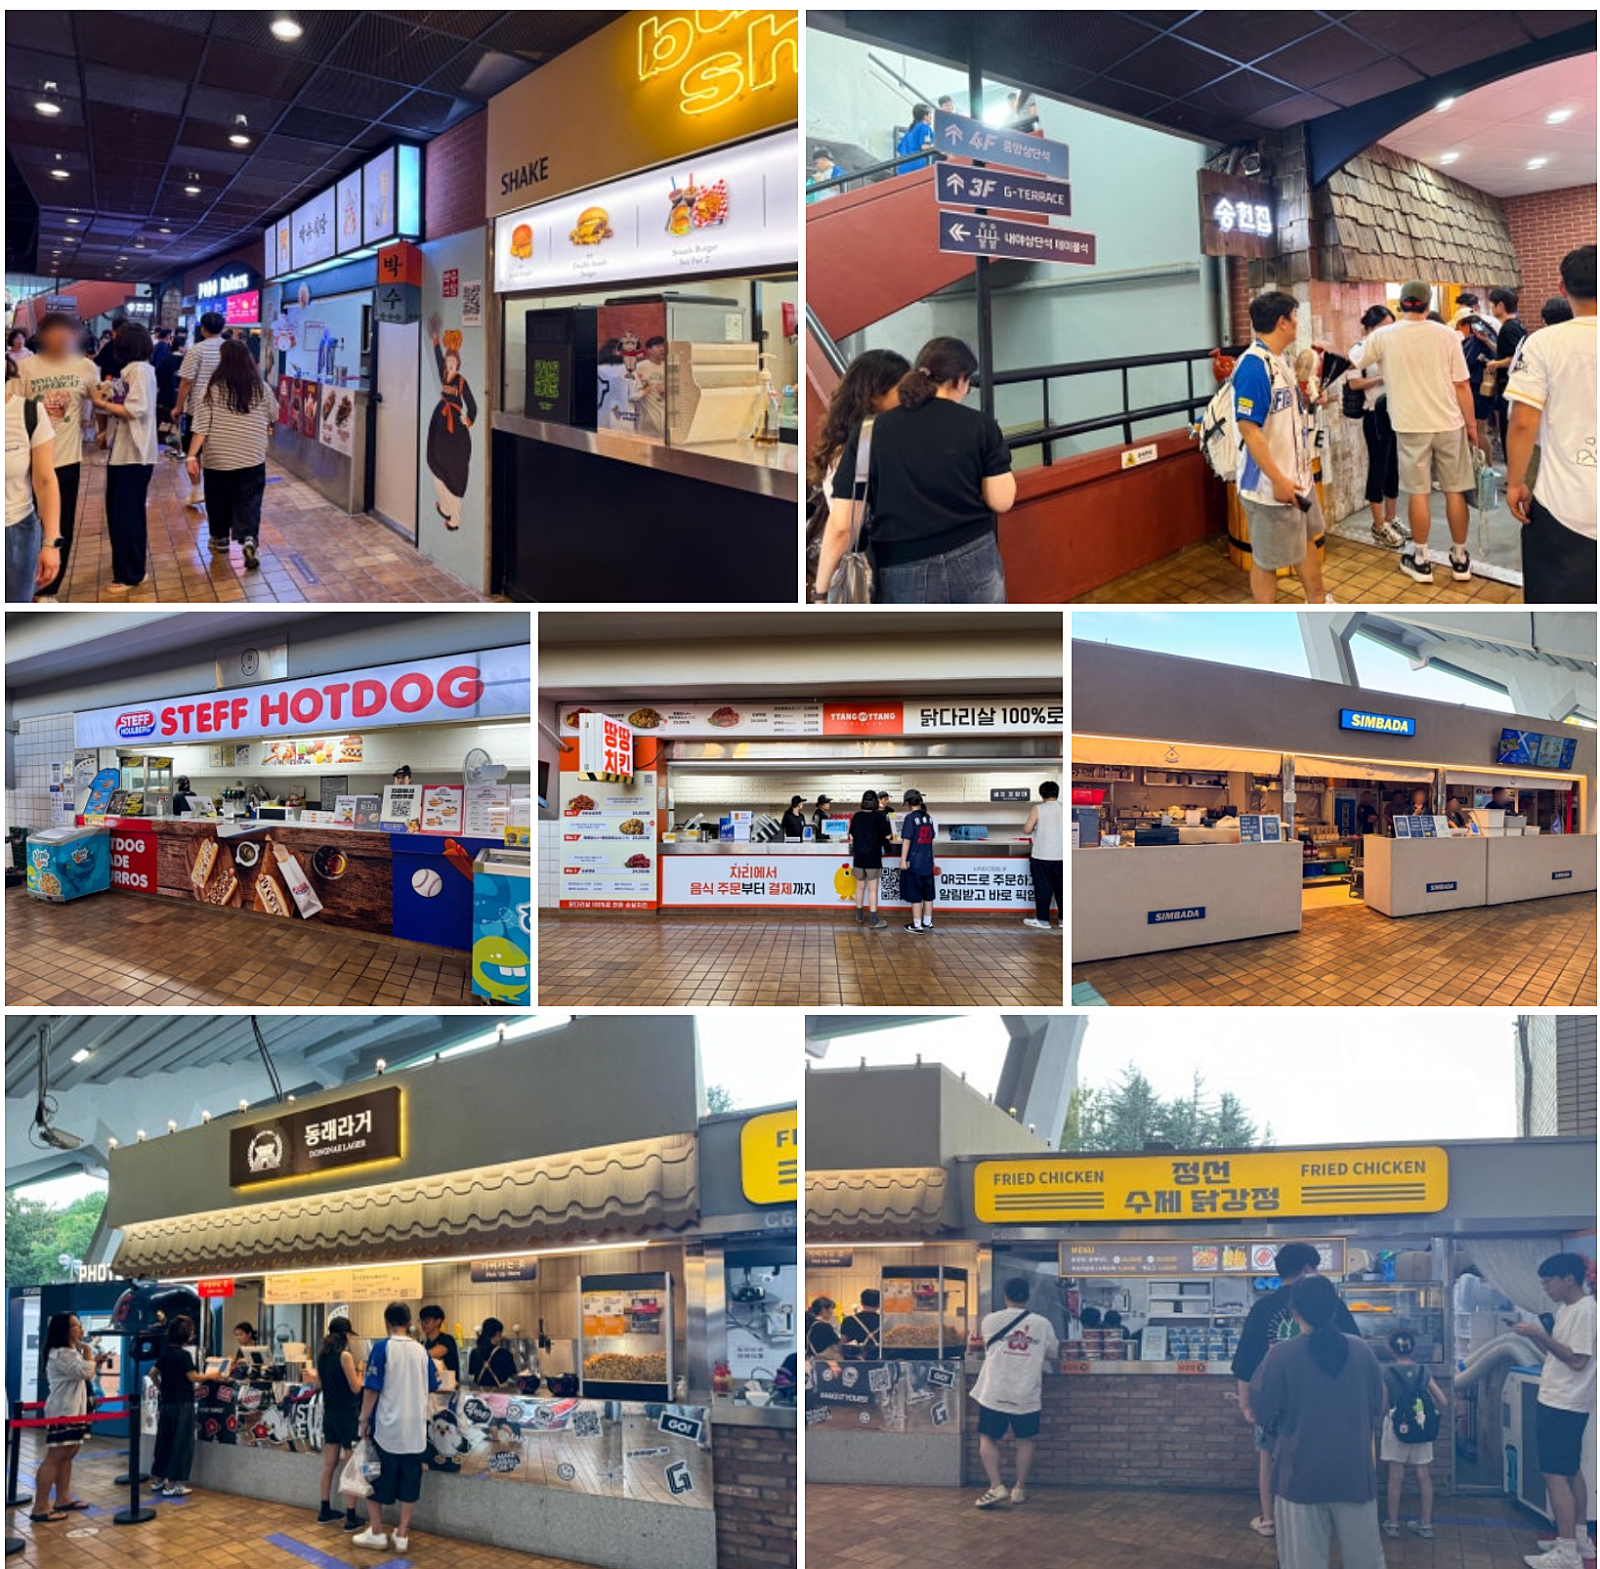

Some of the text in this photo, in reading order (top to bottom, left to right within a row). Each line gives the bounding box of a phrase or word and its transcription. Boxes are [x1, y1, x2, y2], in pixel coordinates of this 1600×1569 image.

[969, 131, 998, 152] 4F
[500, 156, 549, 196] SHAKE
[968, 177, 1065, 206] 3F G-TERRACE
[1004, 231, 1053, 250] 내야상단석
[241, 648, 260, 677] 9
[160, 665, 485, 736] STEFF HOTDOG
[120, 713, 151, 727] STEFF
[830, 712, 896, 721] TTANG TTANG
[919, 706, 1064, 727] 닭다리살 100%로
[1351, 714, 1408, 733] SIMBADA
[119, 725, 151, 736] HOULBERG
[605, 720, 632, 753] 땅땅
[604, 749, 631, 777] 치킨
[729, 864, 778, 879] 자리에서
[940, 873, 990, 886] QR코드로
[690, 882, 816, 896] 음식 주문부터 결제까지
[939, 888, 986, 901] 알림받고
[988, 889, 1013, 902] 바로
[1154, 909, 1200, 922] SIMBADA
[304, 1110, 372, 1147] 동래라거
[308, 1139, 366, 1159] DONGNAE LAGER
[993, 1170, 1105, 1186] FRIED CHICKEN
[1171, 1160, 1231, 1186] 정선
[1300, 1160, 1427, 1178] FRIED CHICKEN
[1124, 1187, 1281, 1214] 수제 닭강정
[1071, 1246, 1095, 1254] MENU
[668, 1418, 693, 1434] GO!
